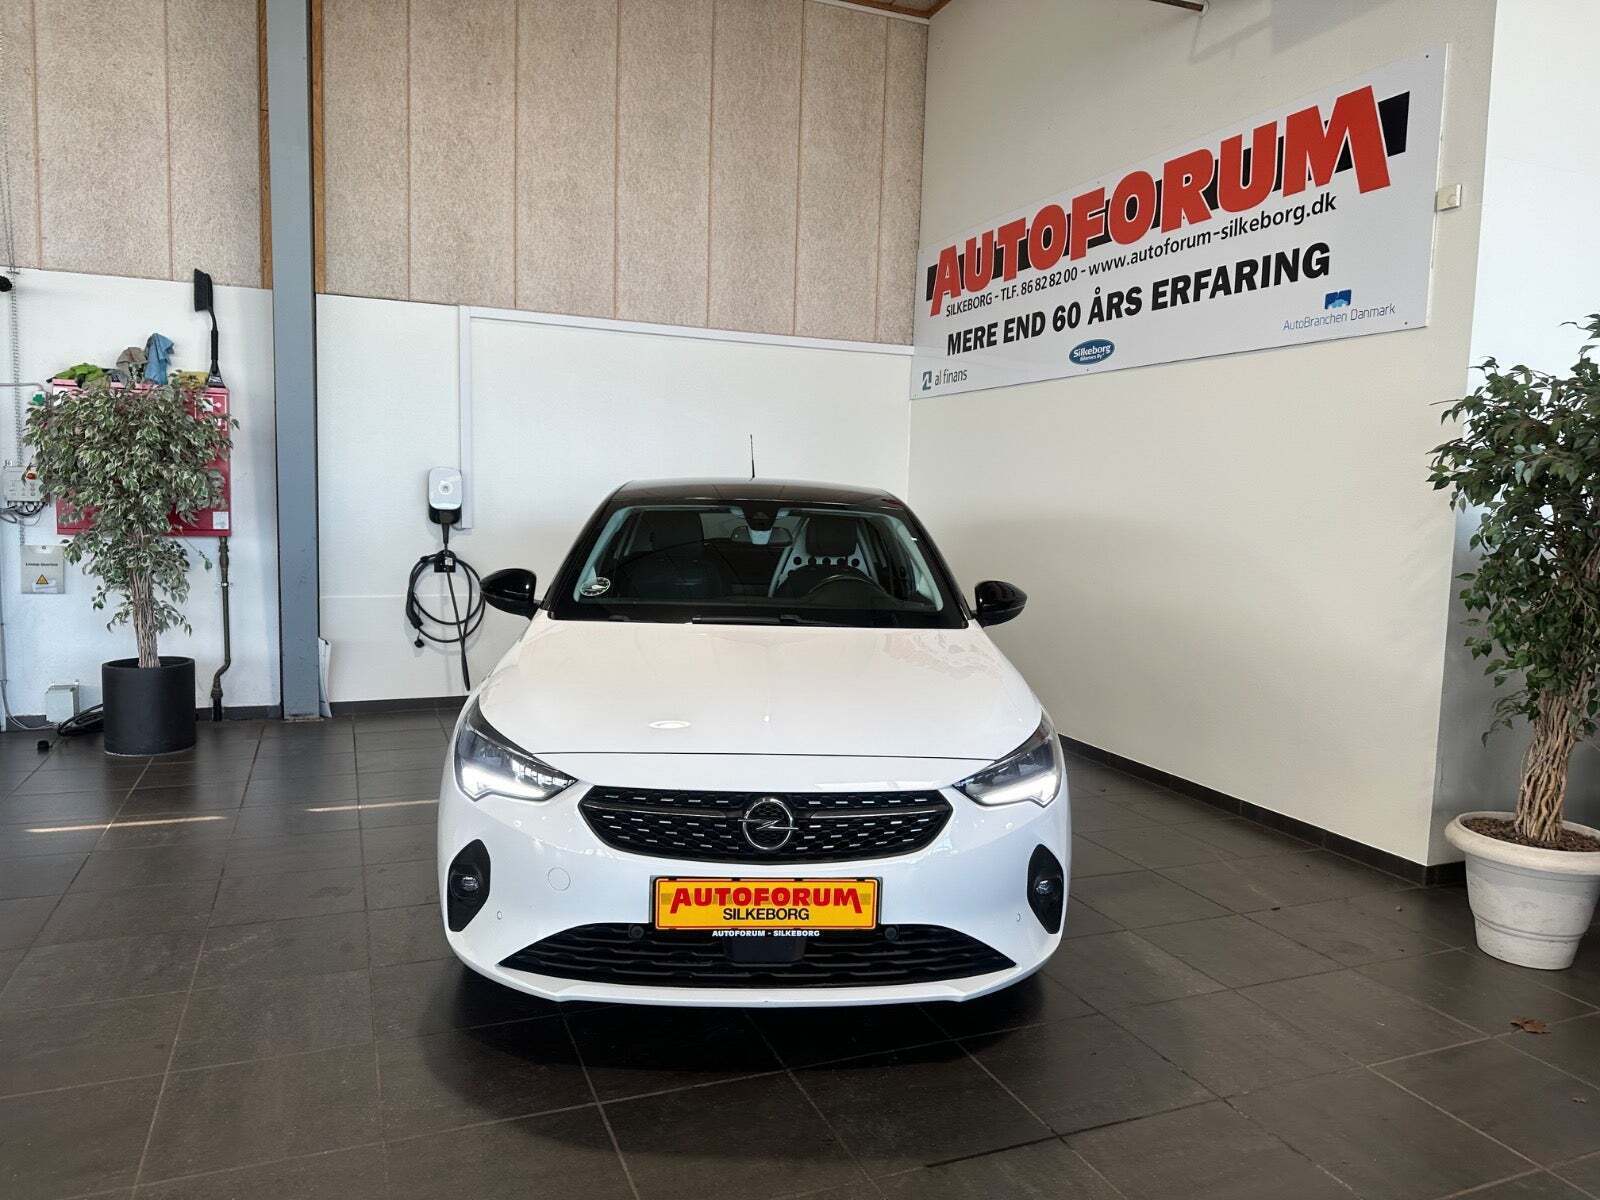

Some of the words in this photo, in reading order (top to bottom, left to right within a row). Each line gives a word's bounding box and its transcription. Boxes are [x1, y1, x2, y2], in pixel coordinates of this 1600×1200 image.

[930, 85, 1391, 317] AUTOFORUM
[945, 292, 993, 317] SILKEBORG
[1001, 285, 1019, 302] TLF.
[1088, 192, 1337, 276] www.autoforum-silkeborg.dk
[947, 322, 999, 356] MERE
[1003, 311, 1046, 344] END
[1052, 301, 1081, 332] 60
[1087, 286, 1143, 325] ÅRS
[1151, 242, 1331, 311] ERFARING
[1283, 312, 1348, 331] AutoBranchen
[1350, 303, 1396, 321] Danmark
[1073, 344, 1112, 358] Silkeborg
[943, 368, 968, 385] finans
[670, 887, 863, 914] AUTOFORUM
[723, 908, 809, 921] SILKEBORG
